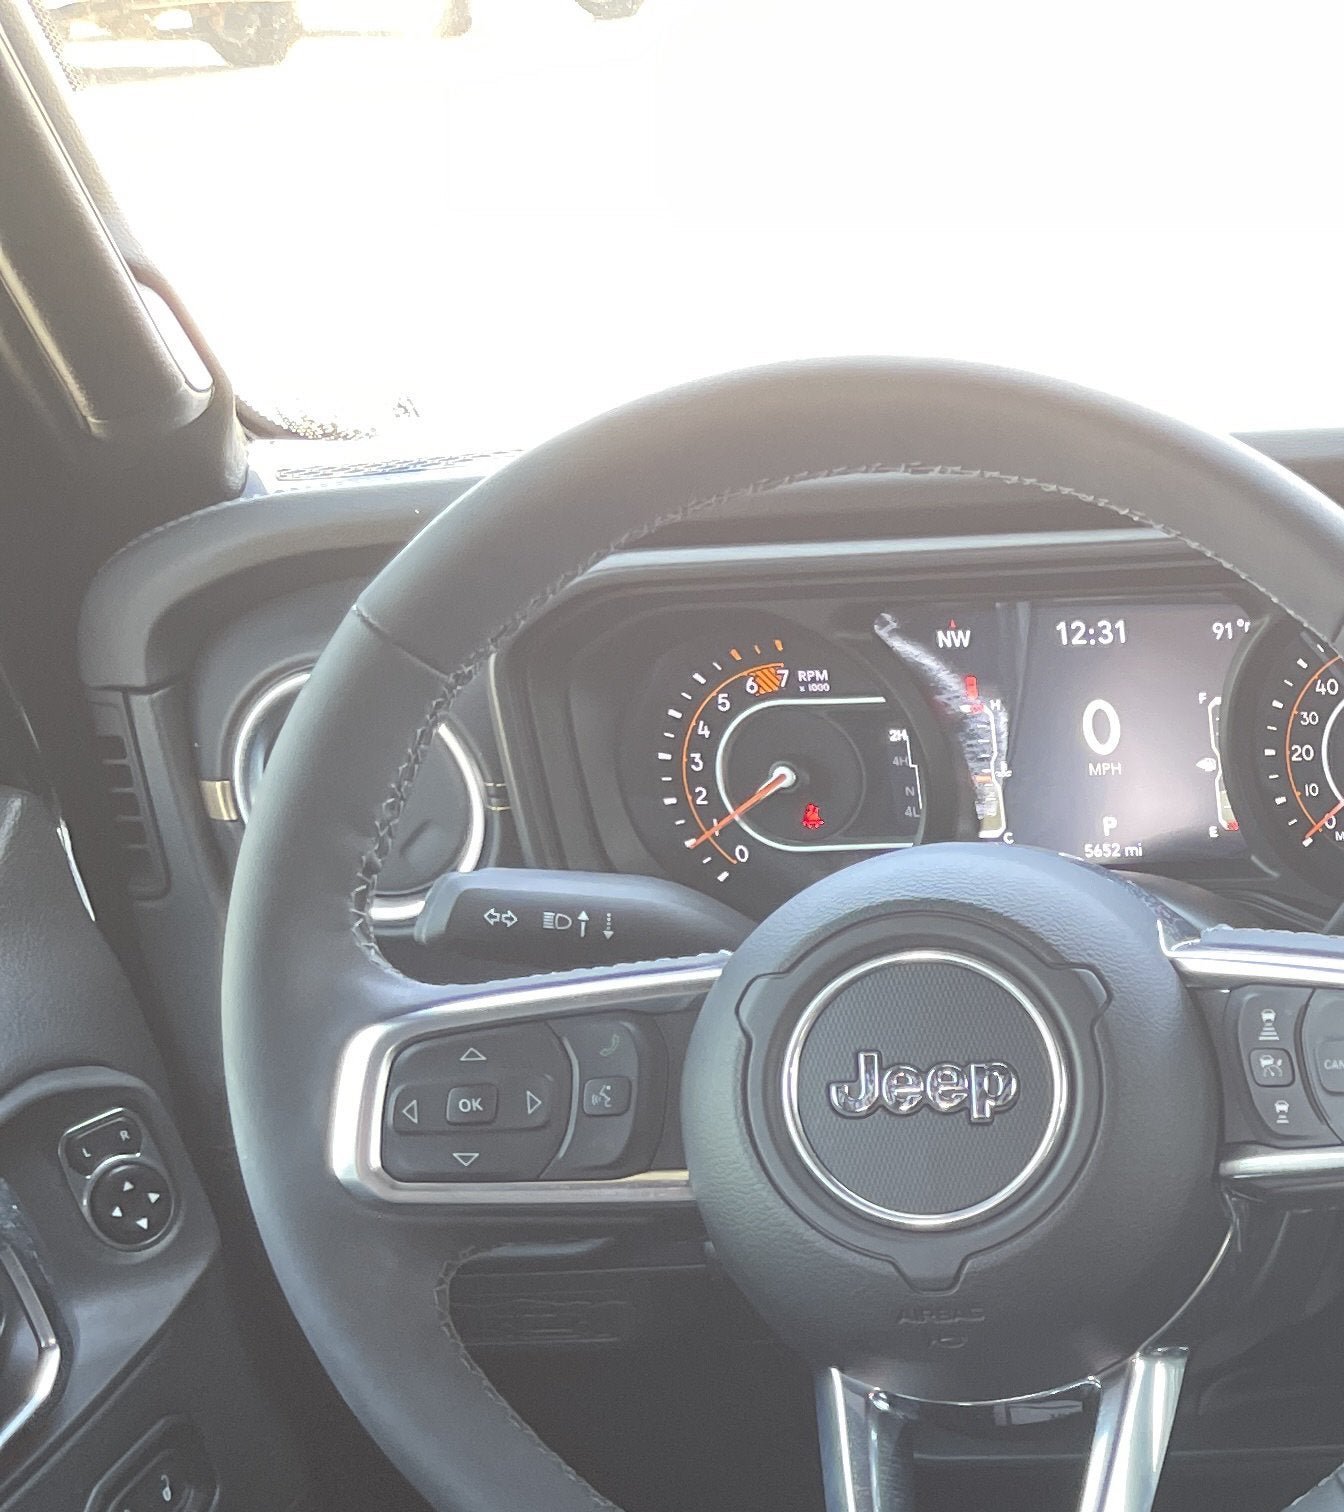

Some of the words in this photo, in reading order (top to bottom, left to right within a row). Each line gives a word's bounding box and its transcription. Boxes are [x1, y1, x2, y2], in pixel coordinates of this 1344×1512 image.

[937, 630, 970, 648] NW
[1056, 619, 1127, 646] 12:31
[776, 670, 790, 688] 7
[798, 670, 829, 681] RPM
[745, 677, 758, 695] 6
[808, 683, 830, 692] 1000
[1315, 679, 1339, 696] 40
[717, 694, 731, 712] 5
[1300, 711, 1319, 726] 30
[697, 720, 710, 738] 4
[889, 729, 908, 742] 2H
[1082, 699, 1121, 756] 0
[892, 757, 908, 766] 4H
[1291, 744, 1314, 762] 20
[690, 754, 703, 771] 3
[1088, 762, 1122, 776] MPH
[694, 788, 708, 805] 2
[1304, 783, 1319, 796] 10
[1103, 816, 1117, 838] P
[1003, 832, 1014, 844] C
[735, 845, 749, 862] 0
[1085, 843, 1121, 858] 5652
[1125, 843, 1143, 857] mi
[830, 1051, 1019, 1123] Jeep
[458, 1098, 483, 1112] OK
[120, 1130, 130, 1141] R
[82, 1147, 91, 1158] L
